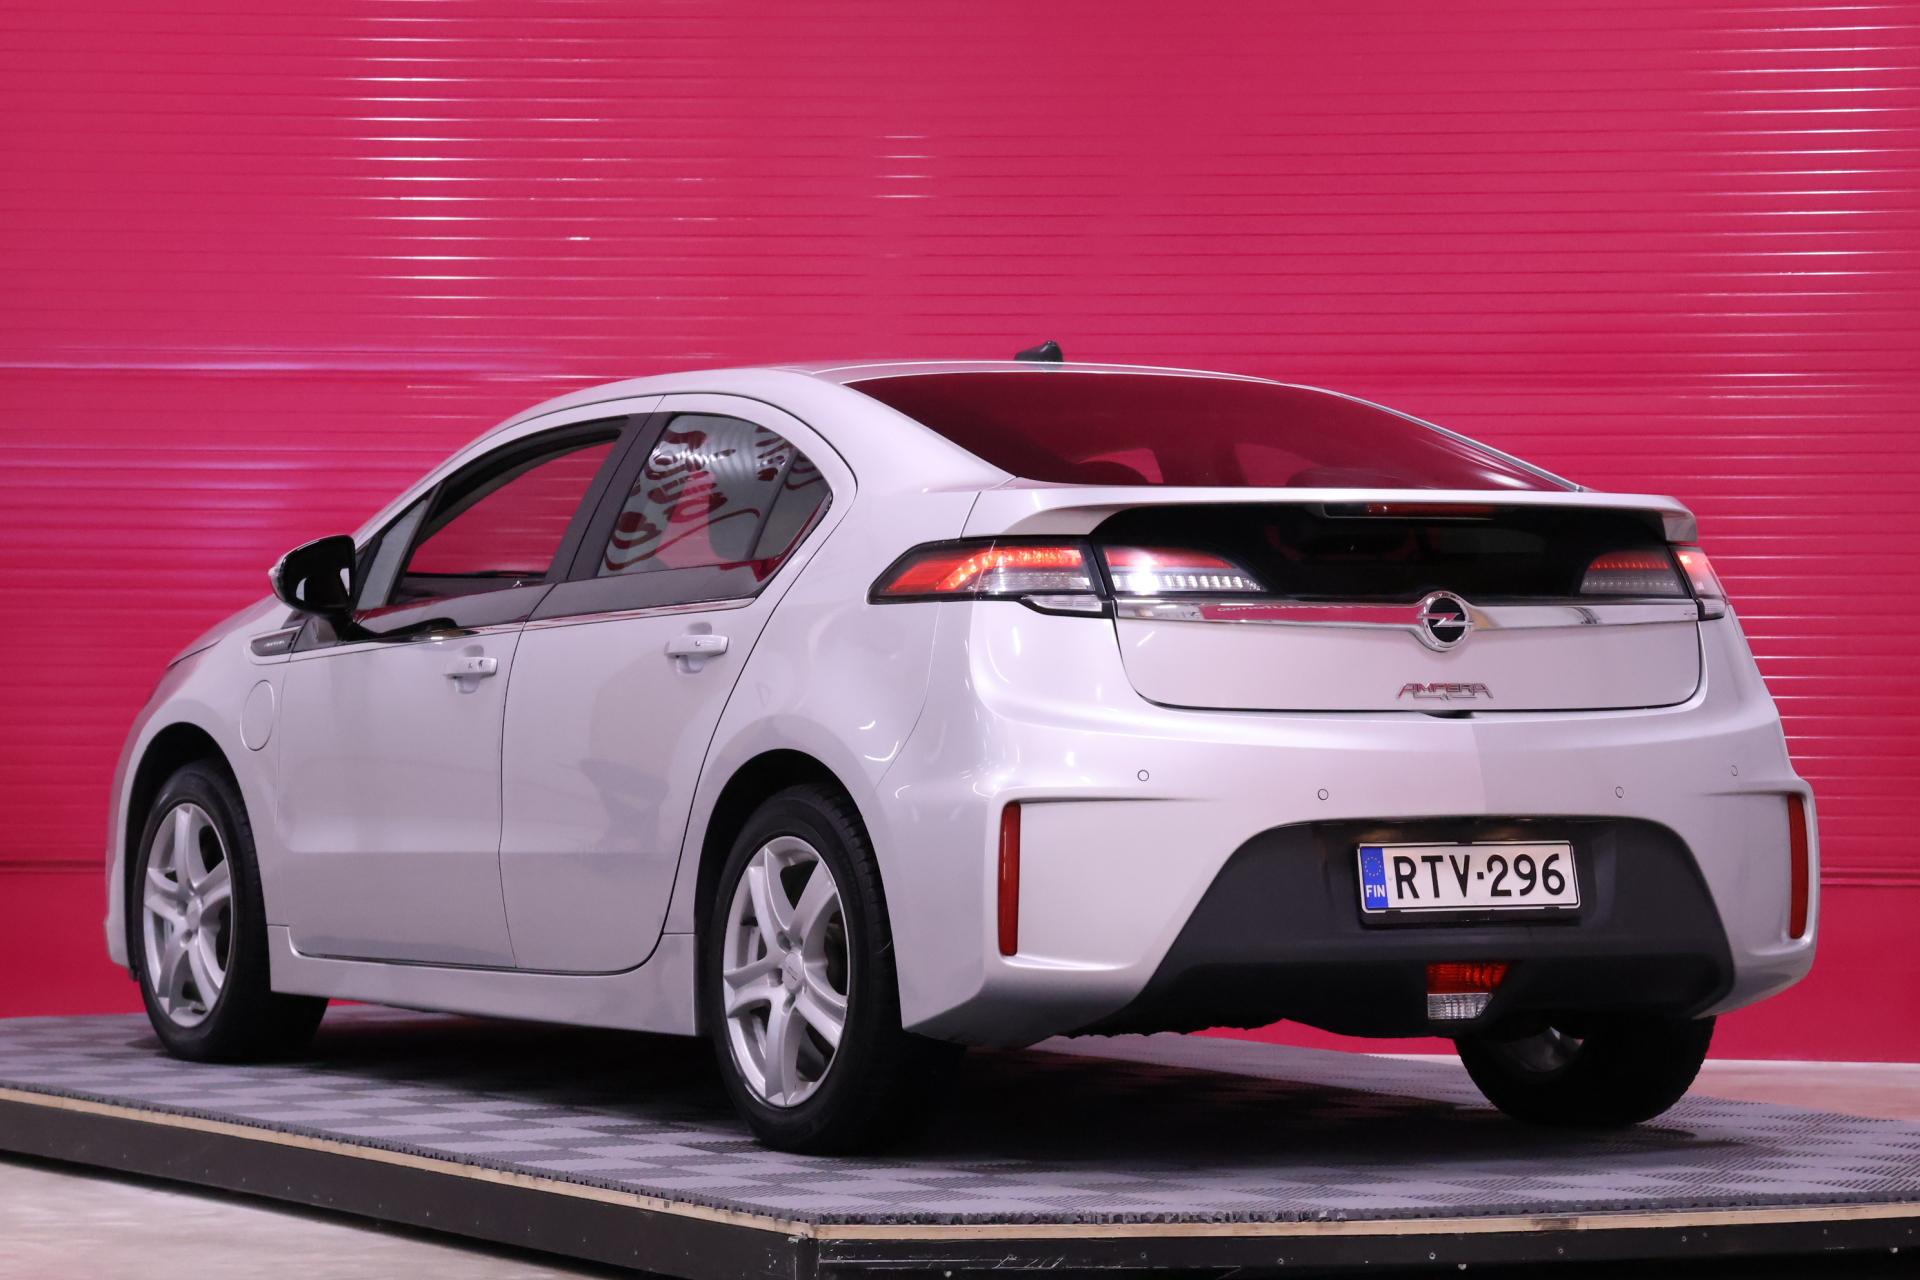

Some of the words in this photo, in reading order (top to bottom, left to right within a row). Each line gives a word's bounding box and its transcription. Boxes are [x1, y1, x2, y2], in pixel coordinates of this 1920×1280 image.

[1397, 682, 1494, 700] AMPERA
[1393, 853, 1566, 899] RTV-296
[1365, 884, 1386, 898] FIN
